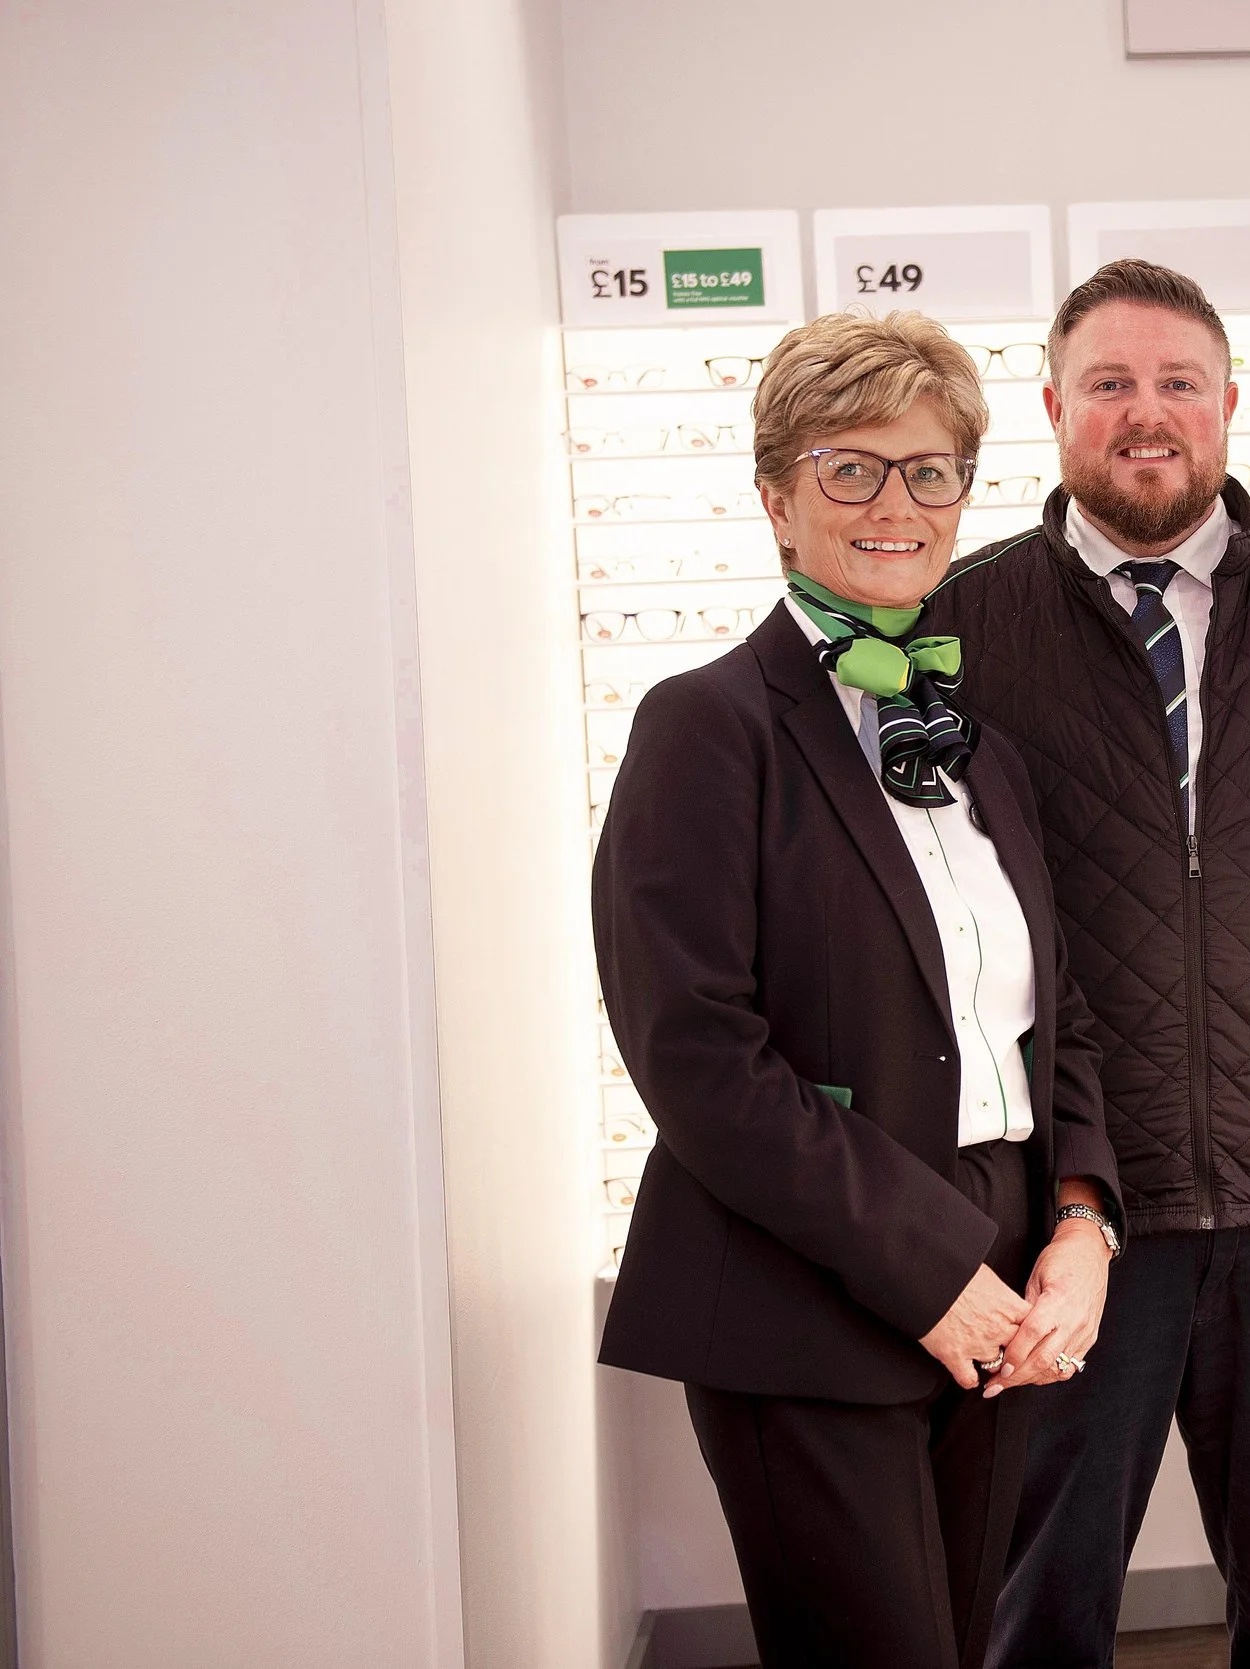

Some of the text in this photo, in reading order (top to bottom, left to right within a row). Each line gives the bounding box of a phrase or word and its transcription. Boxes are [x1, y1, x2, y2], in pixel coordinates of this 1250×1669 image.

[591, 269, 649, 298] £15
[671, 271, 753, 289] £15 to £49
[857, 264, 923, 293] £49
